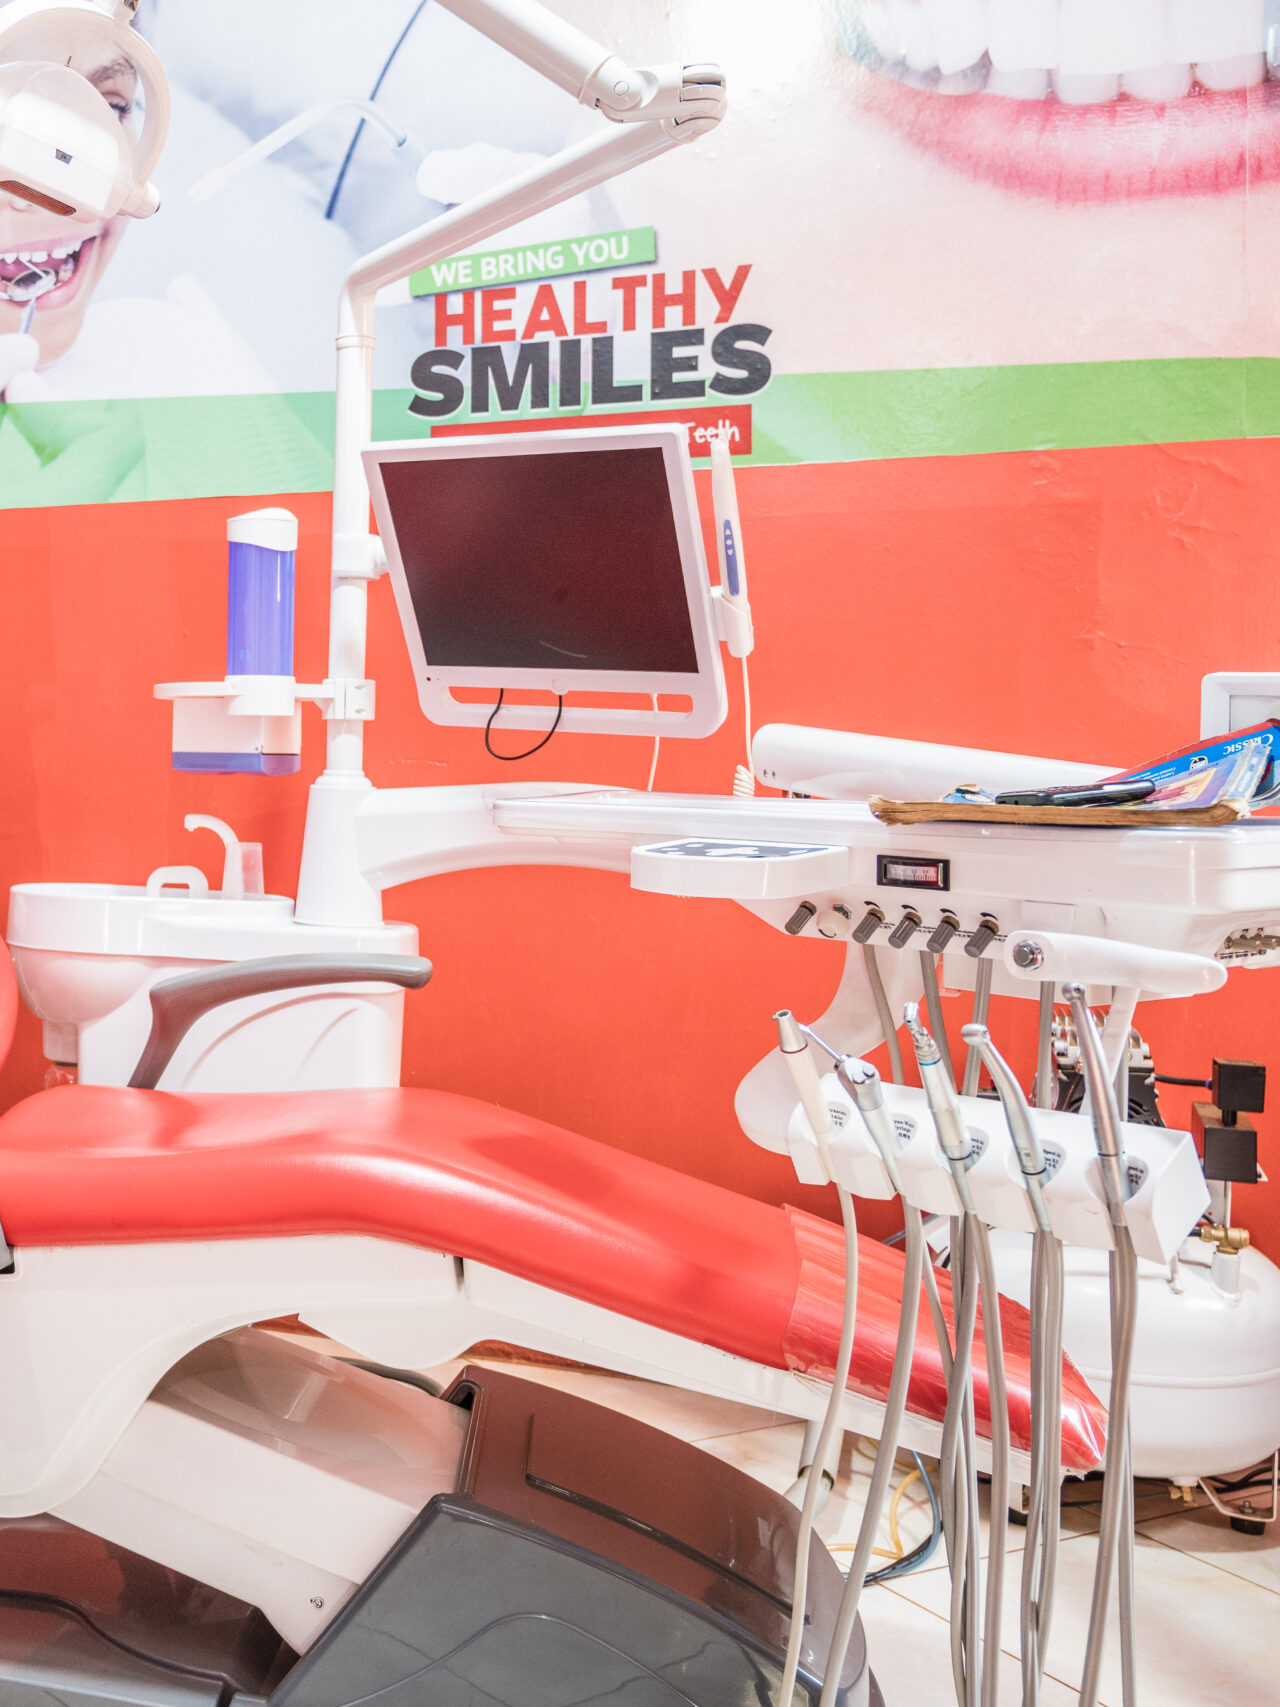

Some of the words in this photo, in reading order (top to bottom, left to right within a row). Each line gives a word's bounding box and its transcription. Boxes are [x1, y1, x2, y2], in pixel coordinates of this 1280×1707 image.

[431, 261, 473, 288] WE
[480, 245, 564, 281] BRING
[570, 235, 630, 263] YOU
[434, 264, 753, 348] HEALTHY
[408, 323, 773, 418] SMILES
